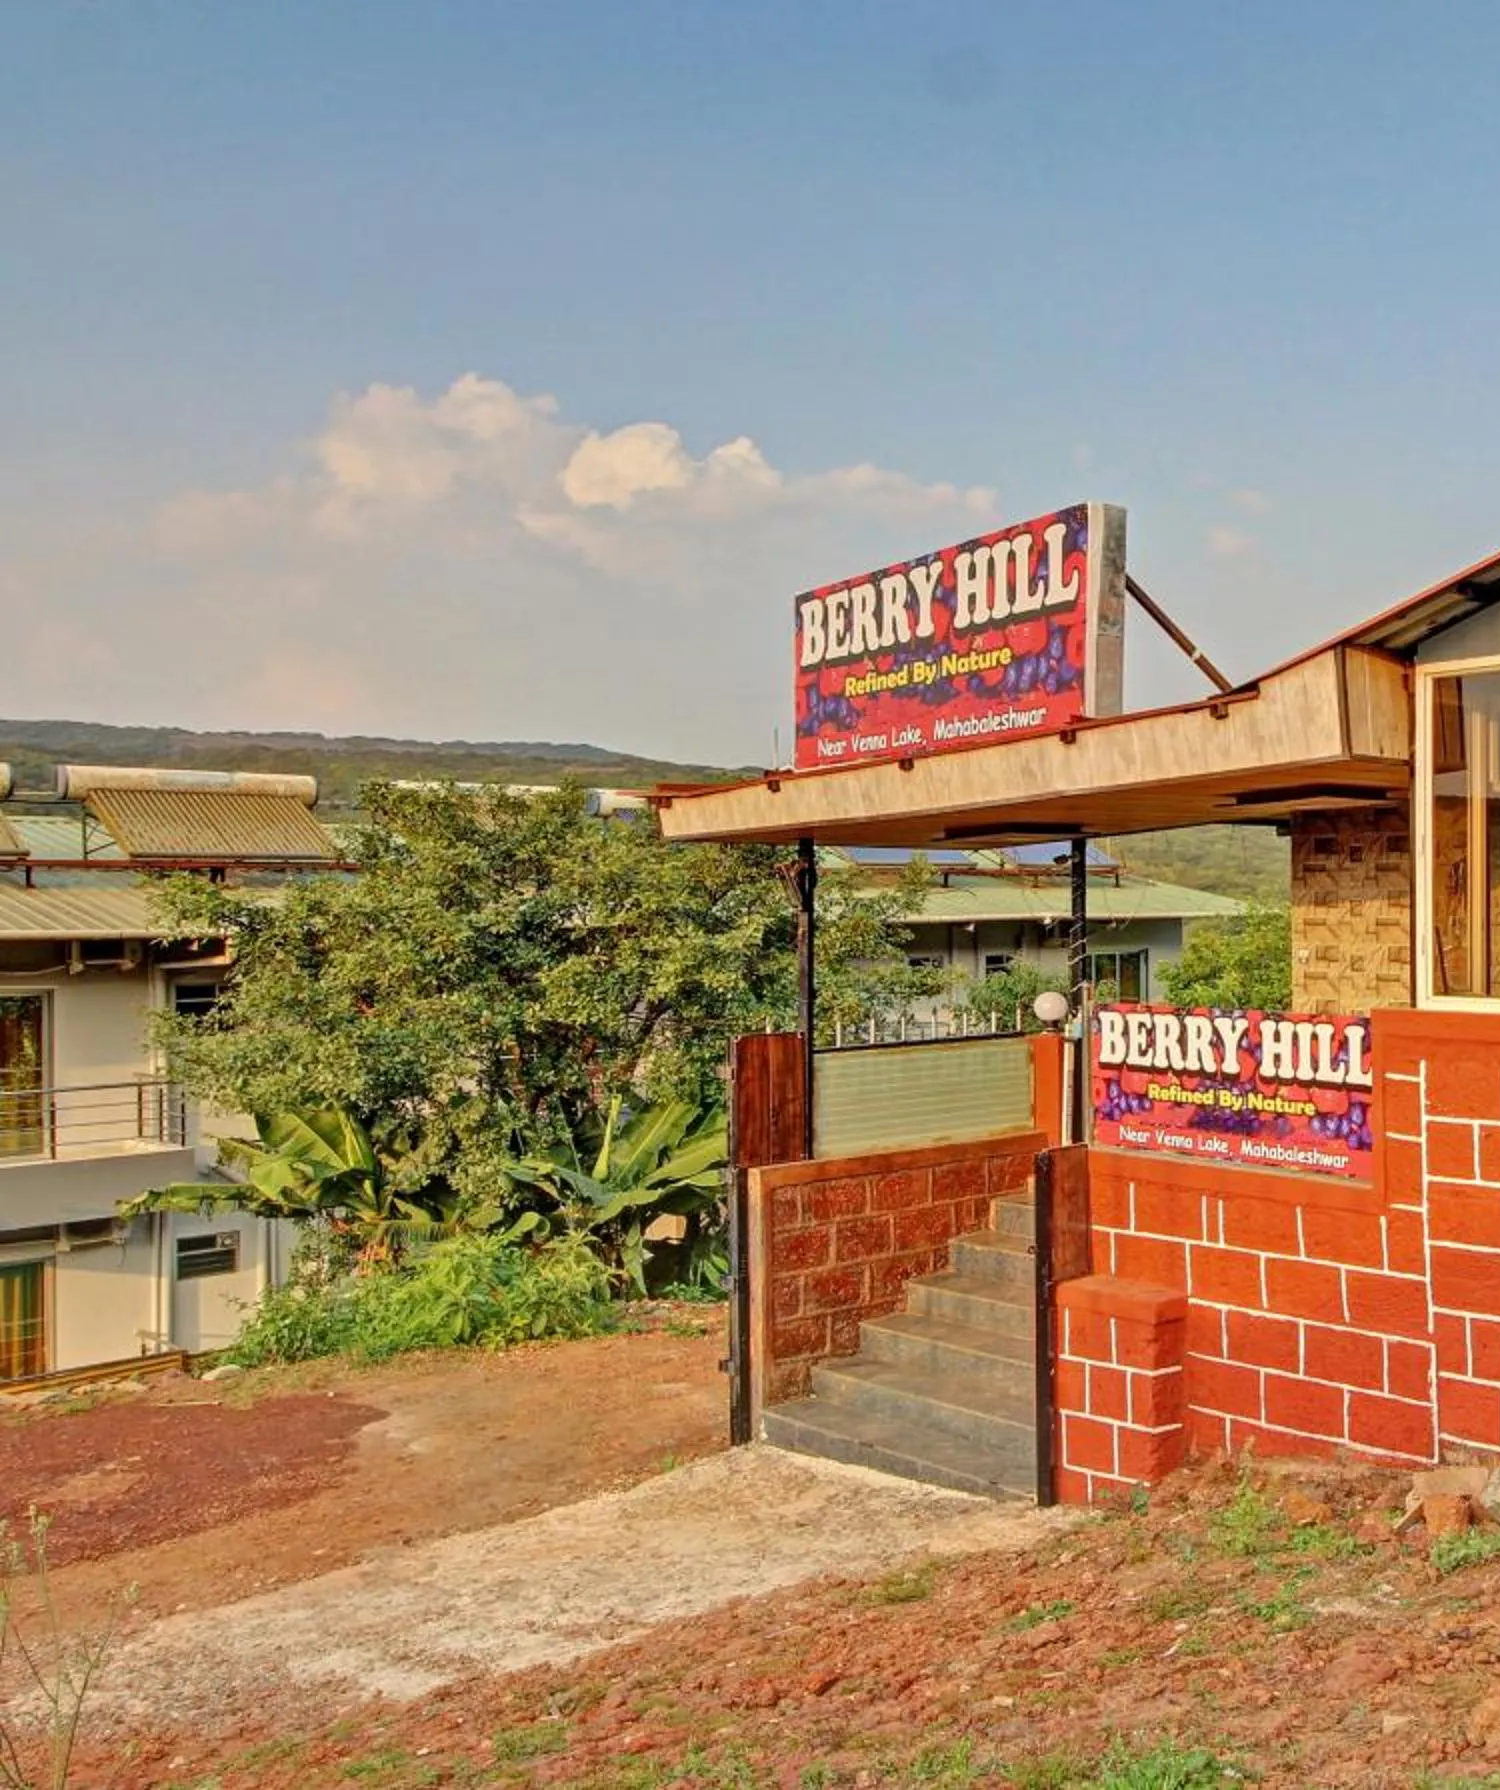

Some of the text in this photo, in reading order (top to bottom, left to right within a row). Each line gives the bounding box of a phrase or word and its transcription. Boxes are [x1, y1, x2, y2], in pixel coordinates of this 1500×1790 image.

[801, 522, 1080, 668] BERRY HILL
[844, 647, 1012, 697] Refined By Nature
[817, 737, 846, 757] Near
[851, 730, 888, 752] Venna
[933, 706, 1046, 741] Mahabaleshwar
[1099, 1011, 1373, 1087] BERRY HILL
[1147, 1083, 1317, 1116] Refined By Nature
[1119, 1126, 1150, 1143] Near
[1155, 1130, 1193, 1150] Venna
[1241, 1140, 1350, 1169] Mahabaleshwar
